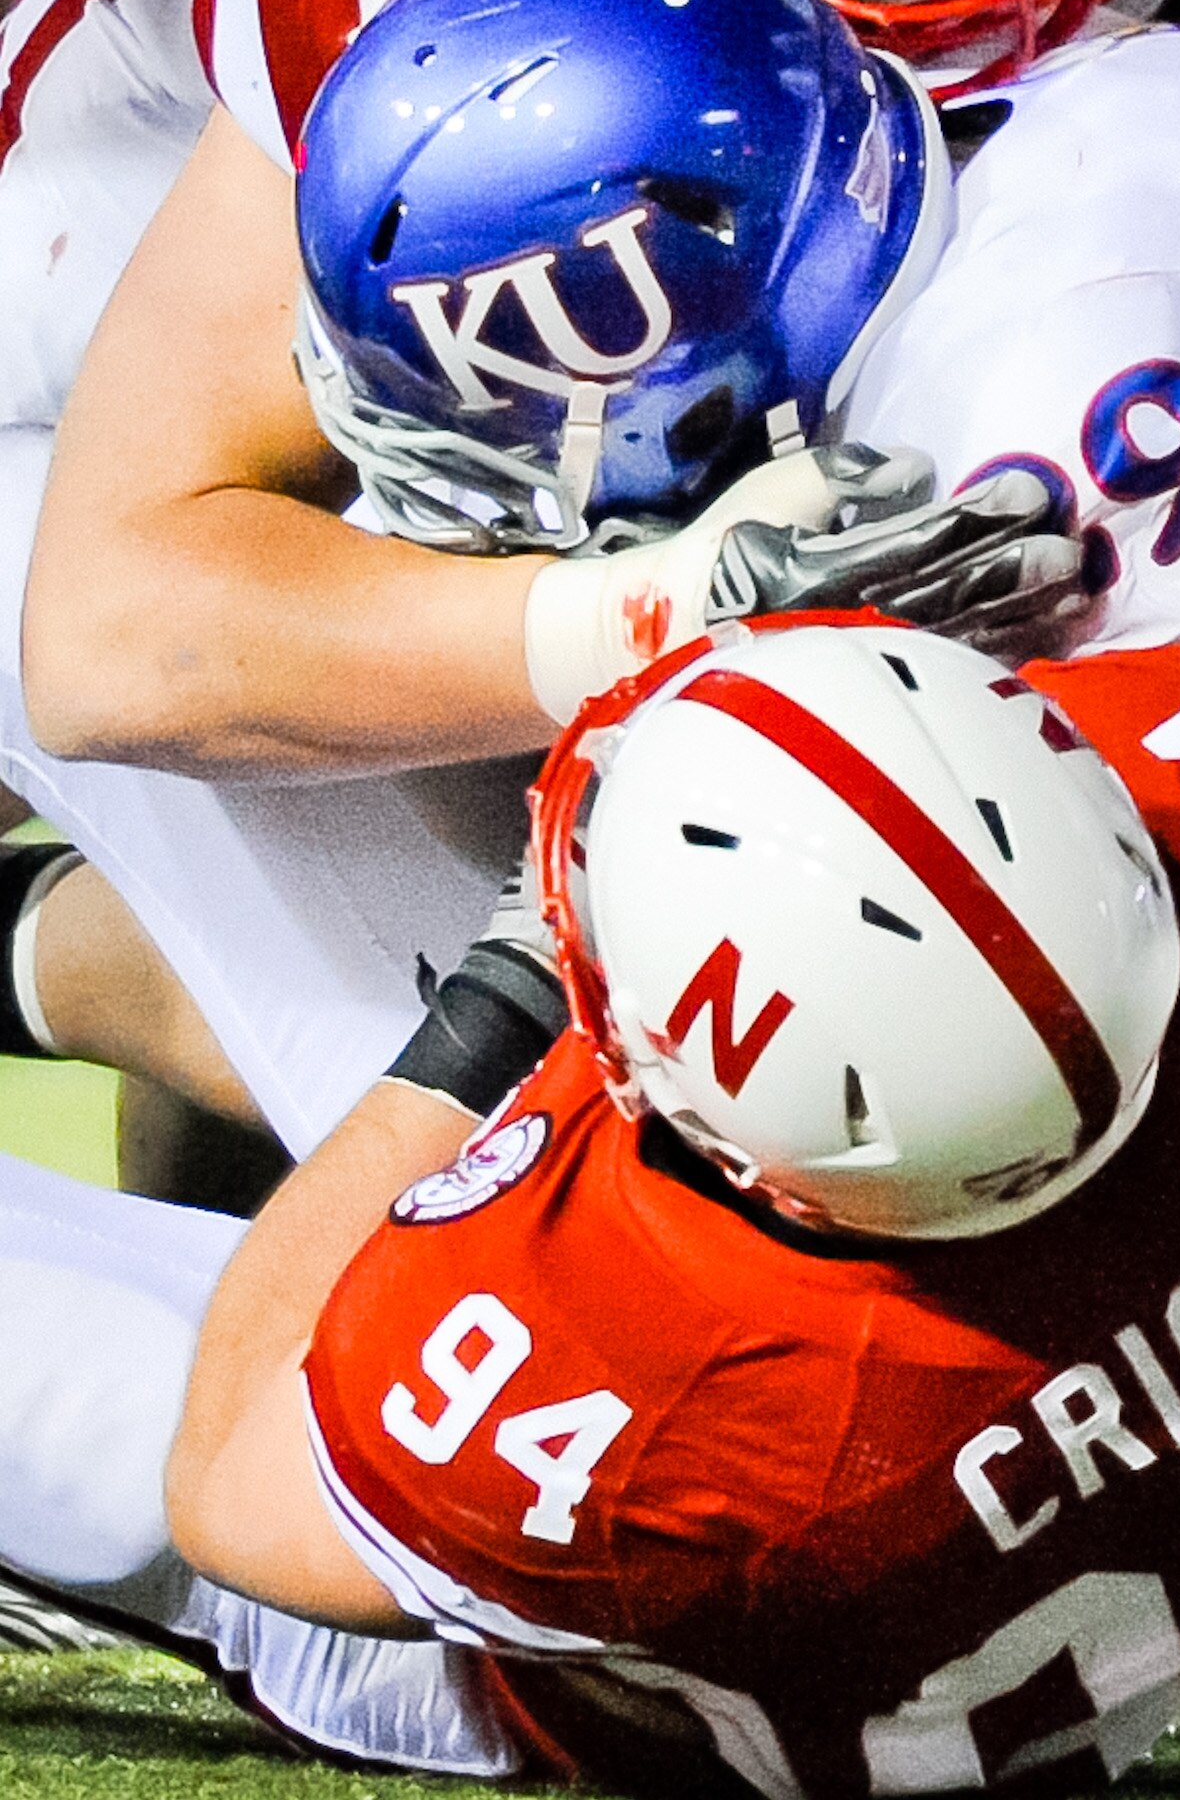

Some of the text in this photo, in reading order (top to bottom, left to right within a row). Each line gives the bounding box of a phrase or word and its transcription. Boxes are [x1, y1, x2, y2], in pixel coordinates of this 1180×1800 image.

[391, 204, 673, 411] KU
[663, 935, 797, 1100] N
[380, 1291, 634, 1545] 94
